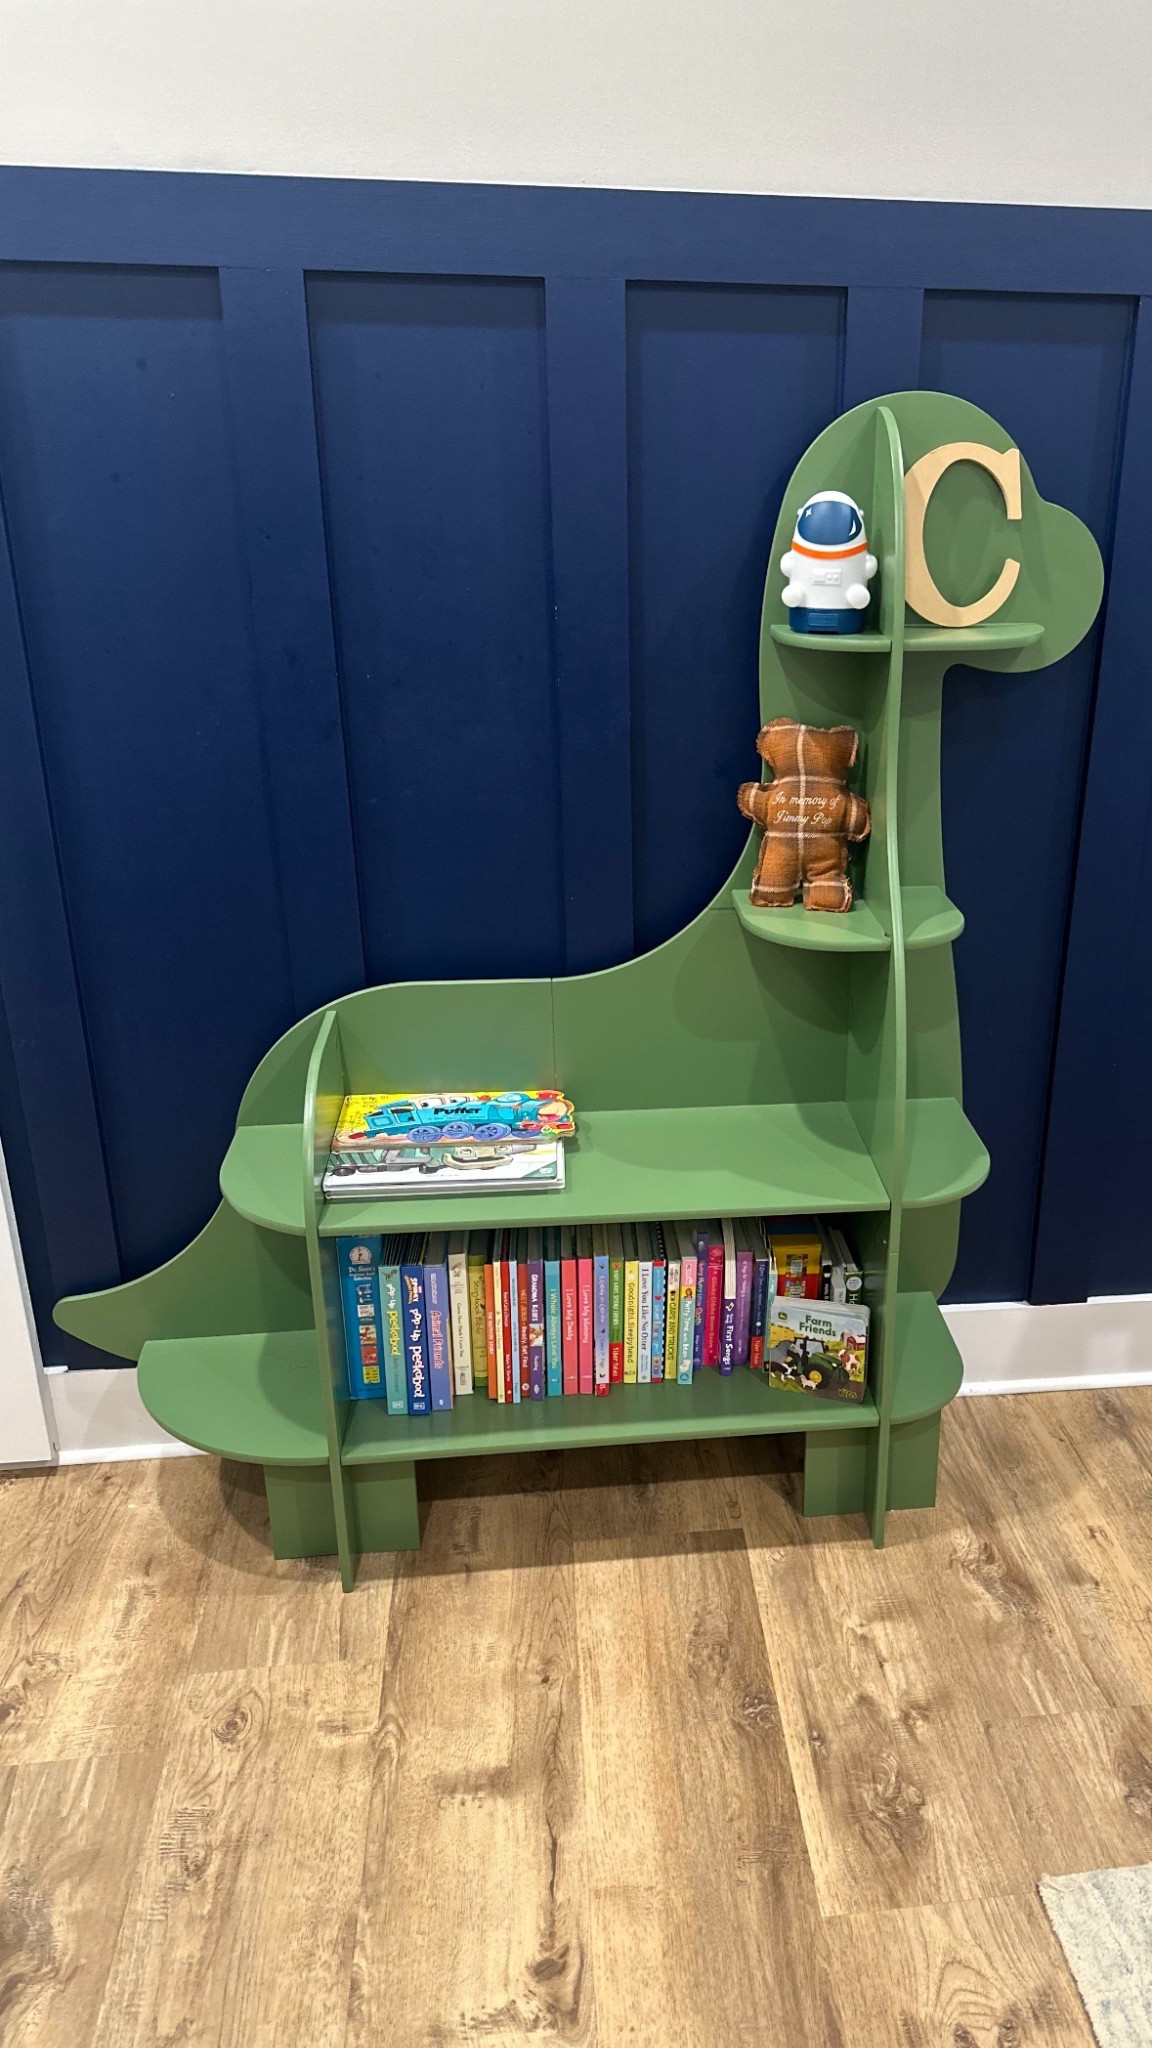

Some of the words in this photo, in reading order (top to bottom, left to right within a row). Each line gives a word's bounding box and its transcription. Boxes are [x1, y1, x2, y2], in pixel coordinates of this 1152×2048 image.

[904, 441, 1022, 628] C
[772, 791, 787, 805] In
[789, 796, 828, 810] memory
[829, 794, 844, 810] of
[773, 810, 809, 825] Jimmy
[810, 812, 833, 828] Pop
[434, 1107, 482, 1115] Puffer
[530, 1274, 539, 1302] GRANDMA
[641, 1273, 649, 1290] Love
[471, 1280, 483, 1315] Storybook
[641, 1291, 649, 1304] You
[565, 1309, 573, 1320] My
[581, 1305, 590, 1317] My
[641, 1305, 649, 1319] Like
[669, 1302, 677, 1320] CARS
[683, 1300, 692, 1316] Potty
[409, 1308, 423, 1342] pop-up
[430, 1310, 442, 1337] Animal
[549, 1316, 557, 1340] Always
[582, 1318, 590, 1343] Mommy
[641, 1321, 648, 1331] No
[668, 1321, 676, 1335] AND
[799, 1321, 837, 1337] Friends
[805, 1315, 832, 1328] Farm
[386, 1310, 401, 1357] peekaboo!
[566, 1321, 574, 1341] Daddy
[726, 1325, 735, 1341] First
[626, 1322, 636, 1363] Sleepyhead
[641, 1332, 649, 1350] Otter
[667, 1335, 675, 1361] TRUCKS
[433, 1339, 445, 1369] Friends
[722, 1343, 733, 1365] Songs
[408, 1345, 425, 1398] peekaboo!
